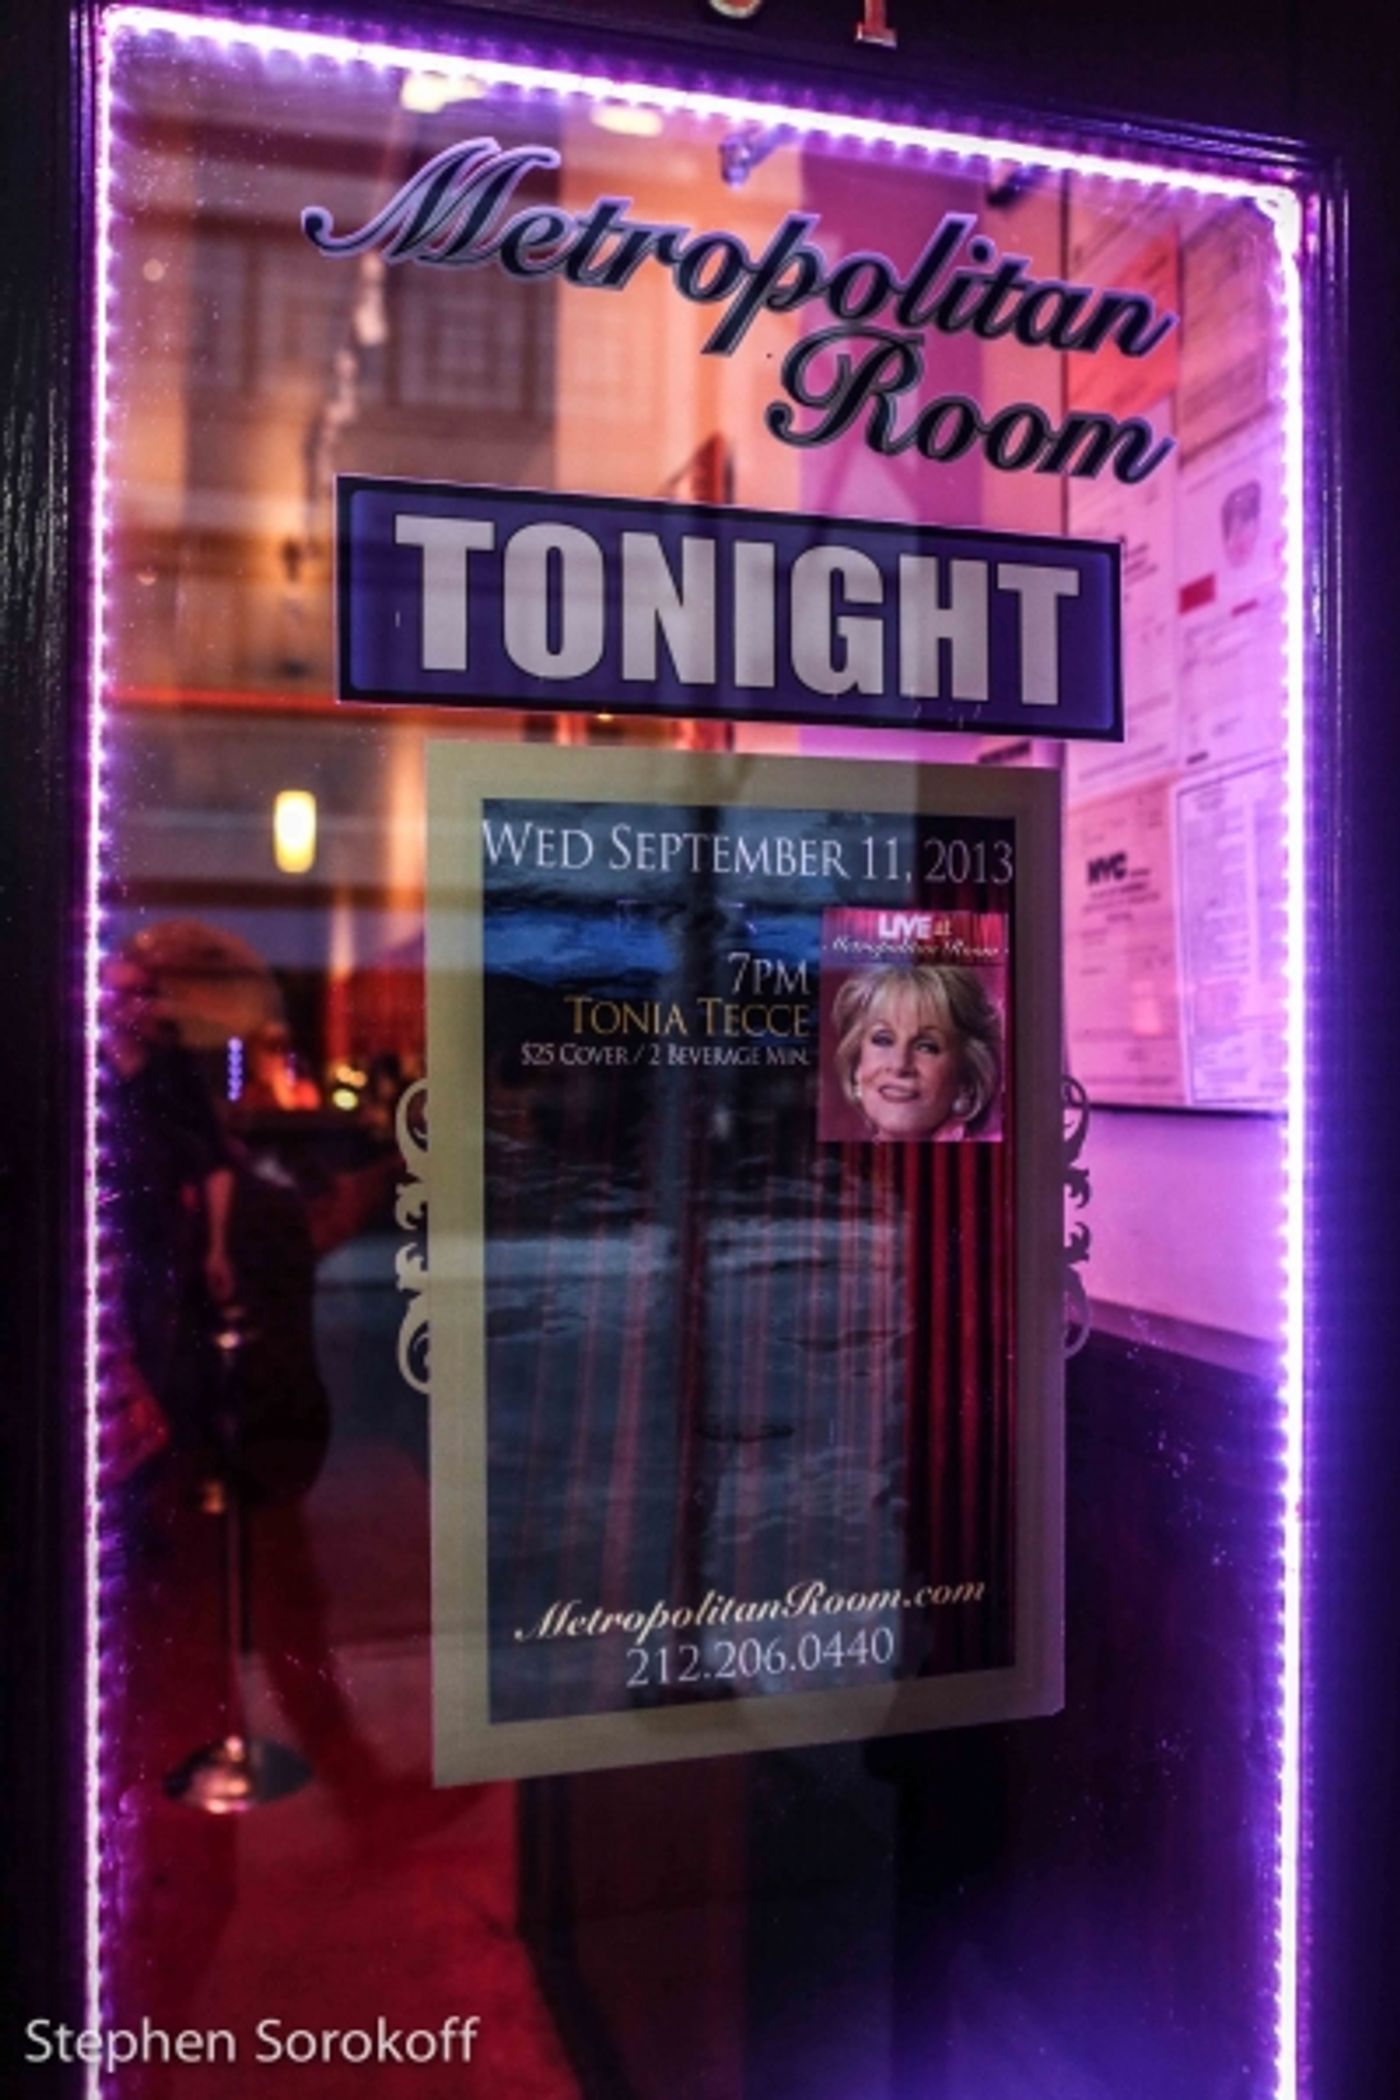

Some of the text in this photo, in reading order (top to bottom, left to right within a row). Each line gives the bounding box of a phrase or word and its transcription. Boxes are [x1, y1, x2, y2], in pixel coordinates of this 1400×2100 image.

[301, 135, 1180, 358] Metropolitan
[763, 326, 1178, 486] Room
[394, 513, 1081, 707] TONIGHT
[483, 819, 1014, 885] WED SEPTEMBER 11, 2013
[1087, 851, 1127, 886] NYC
[878, 912, 932, 939] LIVE
[727, 952, 809, 995] 7PM
[565, 996, 809, 1038] TONIA TECCE
[521, 1042, 554, 1066] $25
[559, 1043, 628, 1066] COVER
[648, 1044, 661, 1066] 2
[668, 1042, 760, 1067] BEVERAGE
[514, 1580, 986, 1645] MetropolitanRoom.com
[625, 1626, 895, 1688] 212.206.0440
